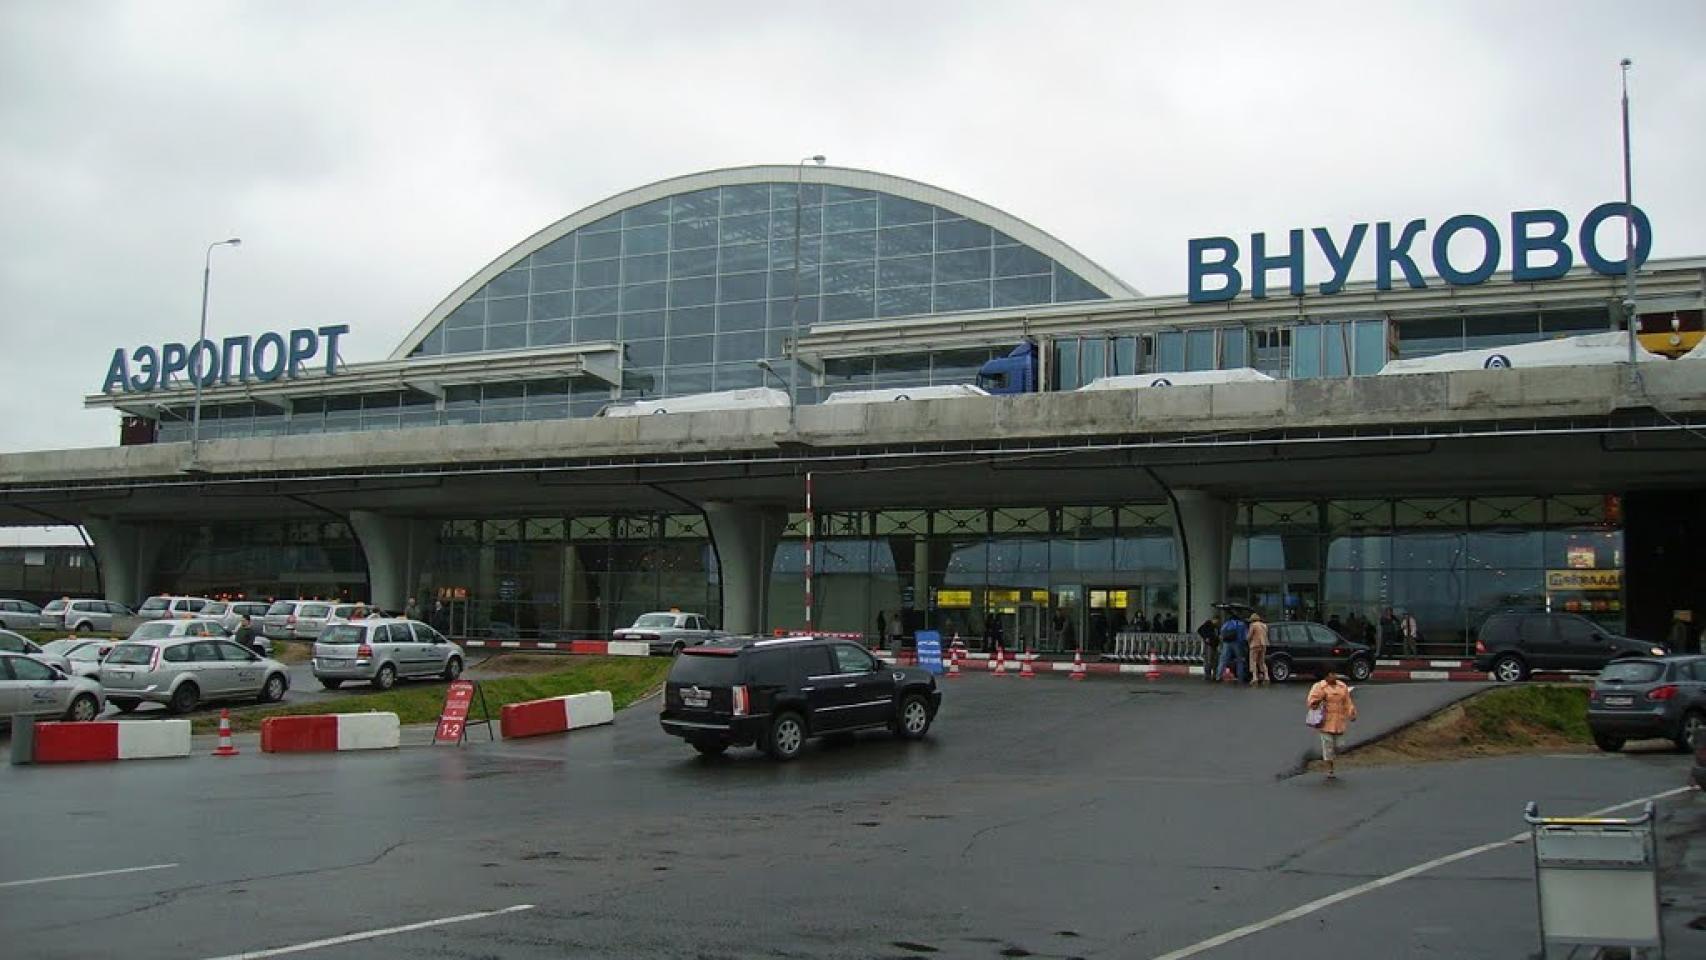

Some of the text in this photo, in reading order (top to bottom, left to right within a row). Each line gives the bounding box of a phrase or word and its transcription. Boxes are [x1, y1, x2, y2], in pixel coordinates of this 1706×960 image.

[1188, 202, 1652, 303] ВНУКОВО
[102, 325, 349, 393] АЭРОПОРТ
[442, 724, 460, 736] 1-2
